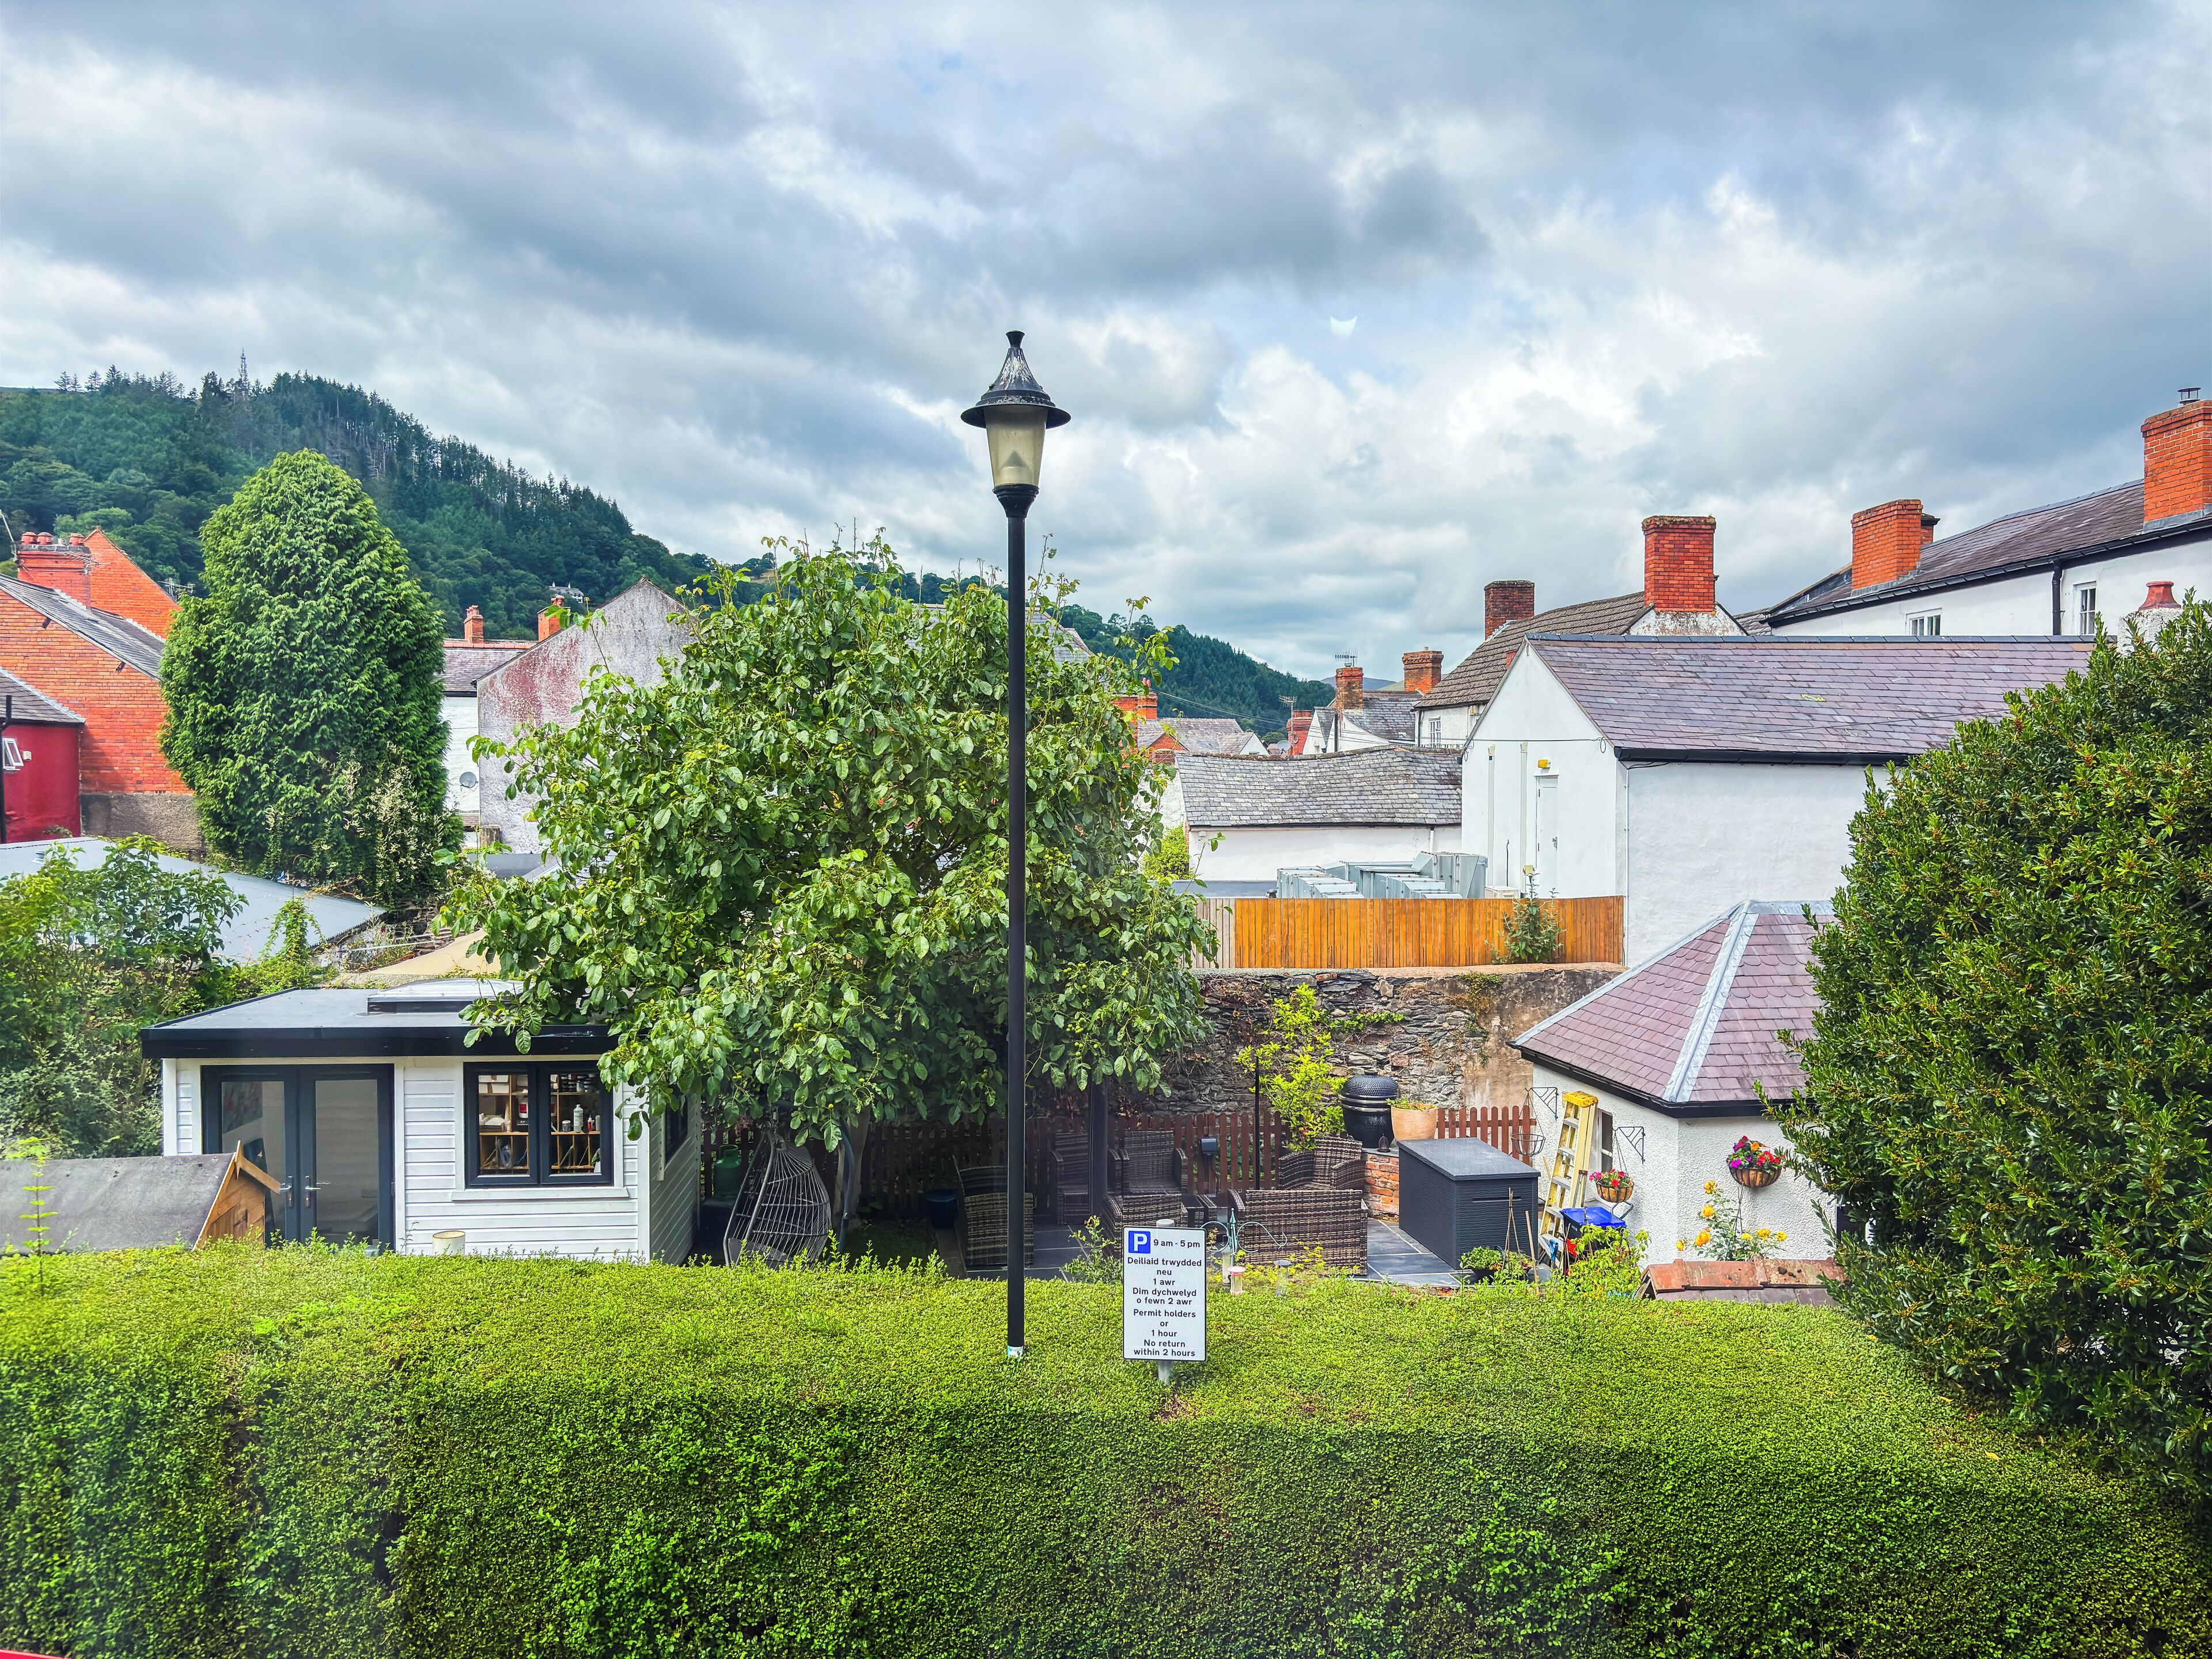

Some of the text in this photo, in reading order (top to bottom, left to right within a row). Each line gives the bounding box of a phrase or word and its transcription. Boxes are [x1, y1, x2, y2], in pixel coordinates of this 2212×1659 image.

[1134, 1233, 1147, 1251] P
[1127, 1257, 1202, 1267] Deiliaid trwydded
[1132, 1287, 1196, 1297] Dim dychwelyd
[1144, 1296, 1165, 1305] fewn
[1133, 1308, 1196, 1318] Permit holders
[1134, 1348, 1160, 1356] within
[1171, 1349, 1195, 1357] hours
